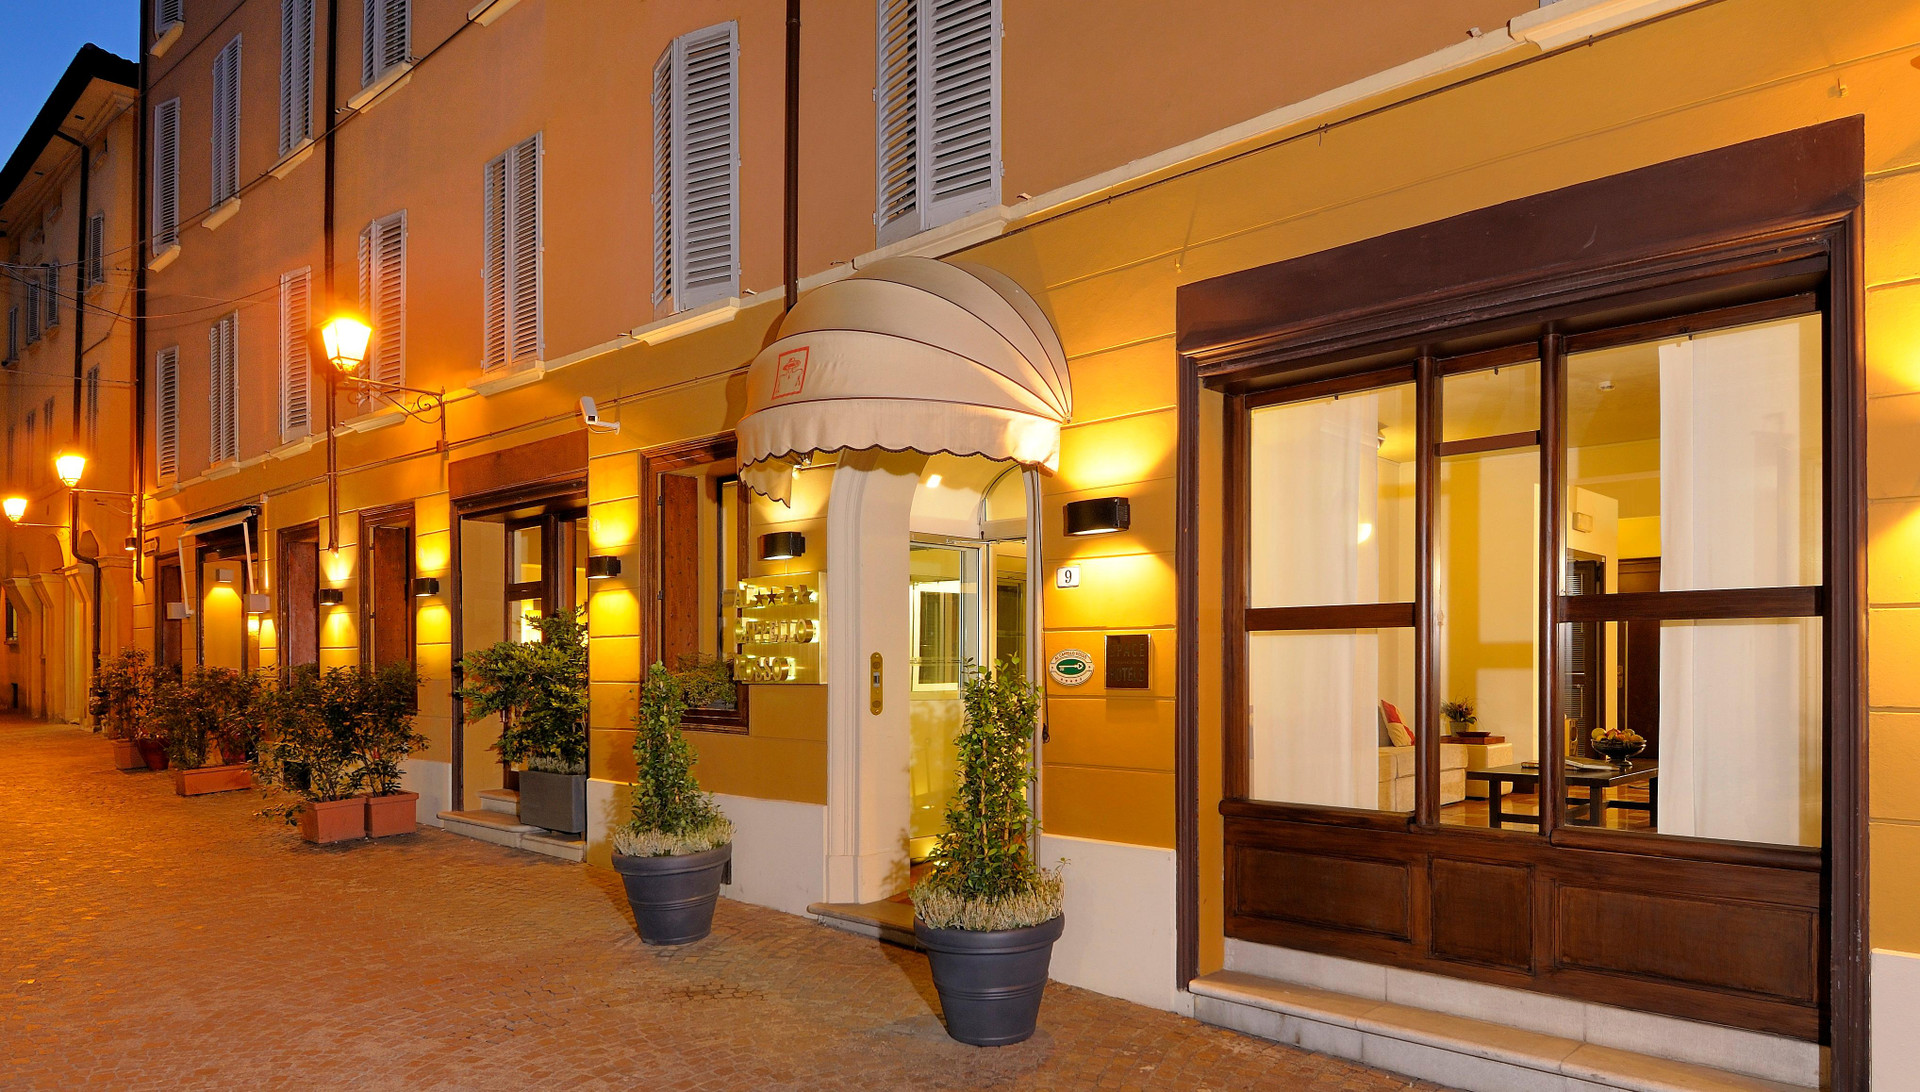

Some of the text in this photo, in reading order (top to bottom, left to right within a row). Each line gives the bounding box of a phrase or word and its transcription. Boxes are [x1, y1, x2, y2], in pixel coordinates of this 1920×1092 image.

[1064, 569, 1072, 584] 9
[1109, 643, 1145, 657] SPACE
[734, 655, 789, 682] ROSSO
